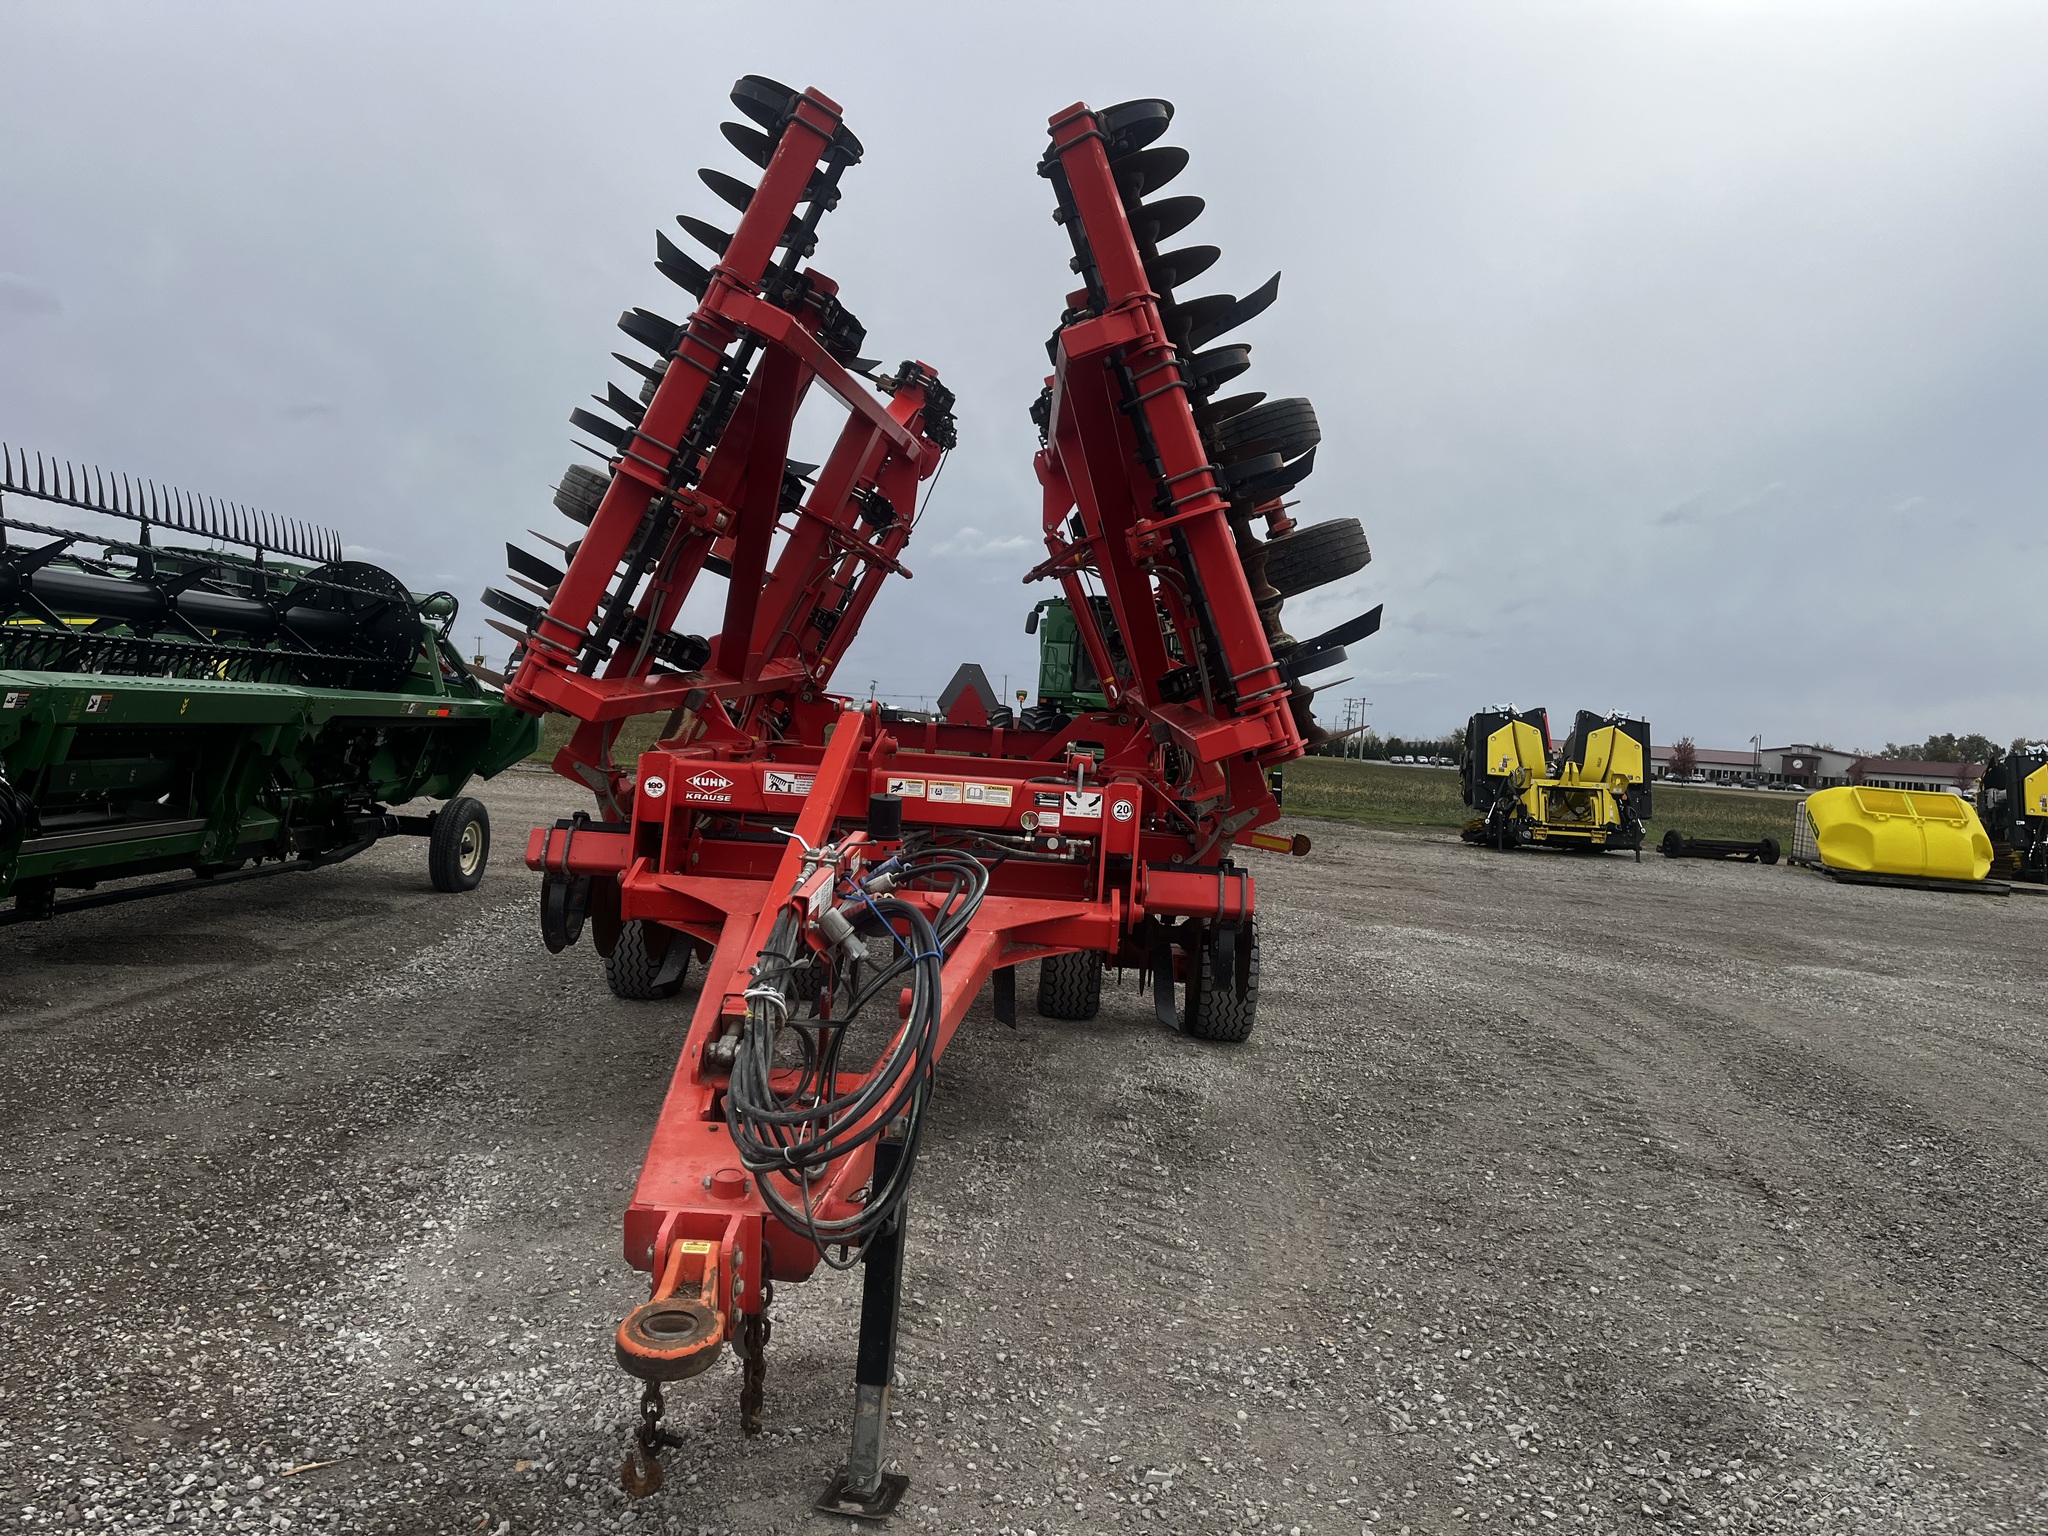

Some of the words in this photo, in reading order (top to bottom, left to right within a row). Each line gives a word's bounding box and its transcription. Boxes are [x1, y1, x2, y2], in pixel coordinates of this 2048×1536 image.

[692, 777, 727, 787] KUHN
[685, 793, 732, 802] KRAUSE
[1116, 804, 1130, 814] 20
